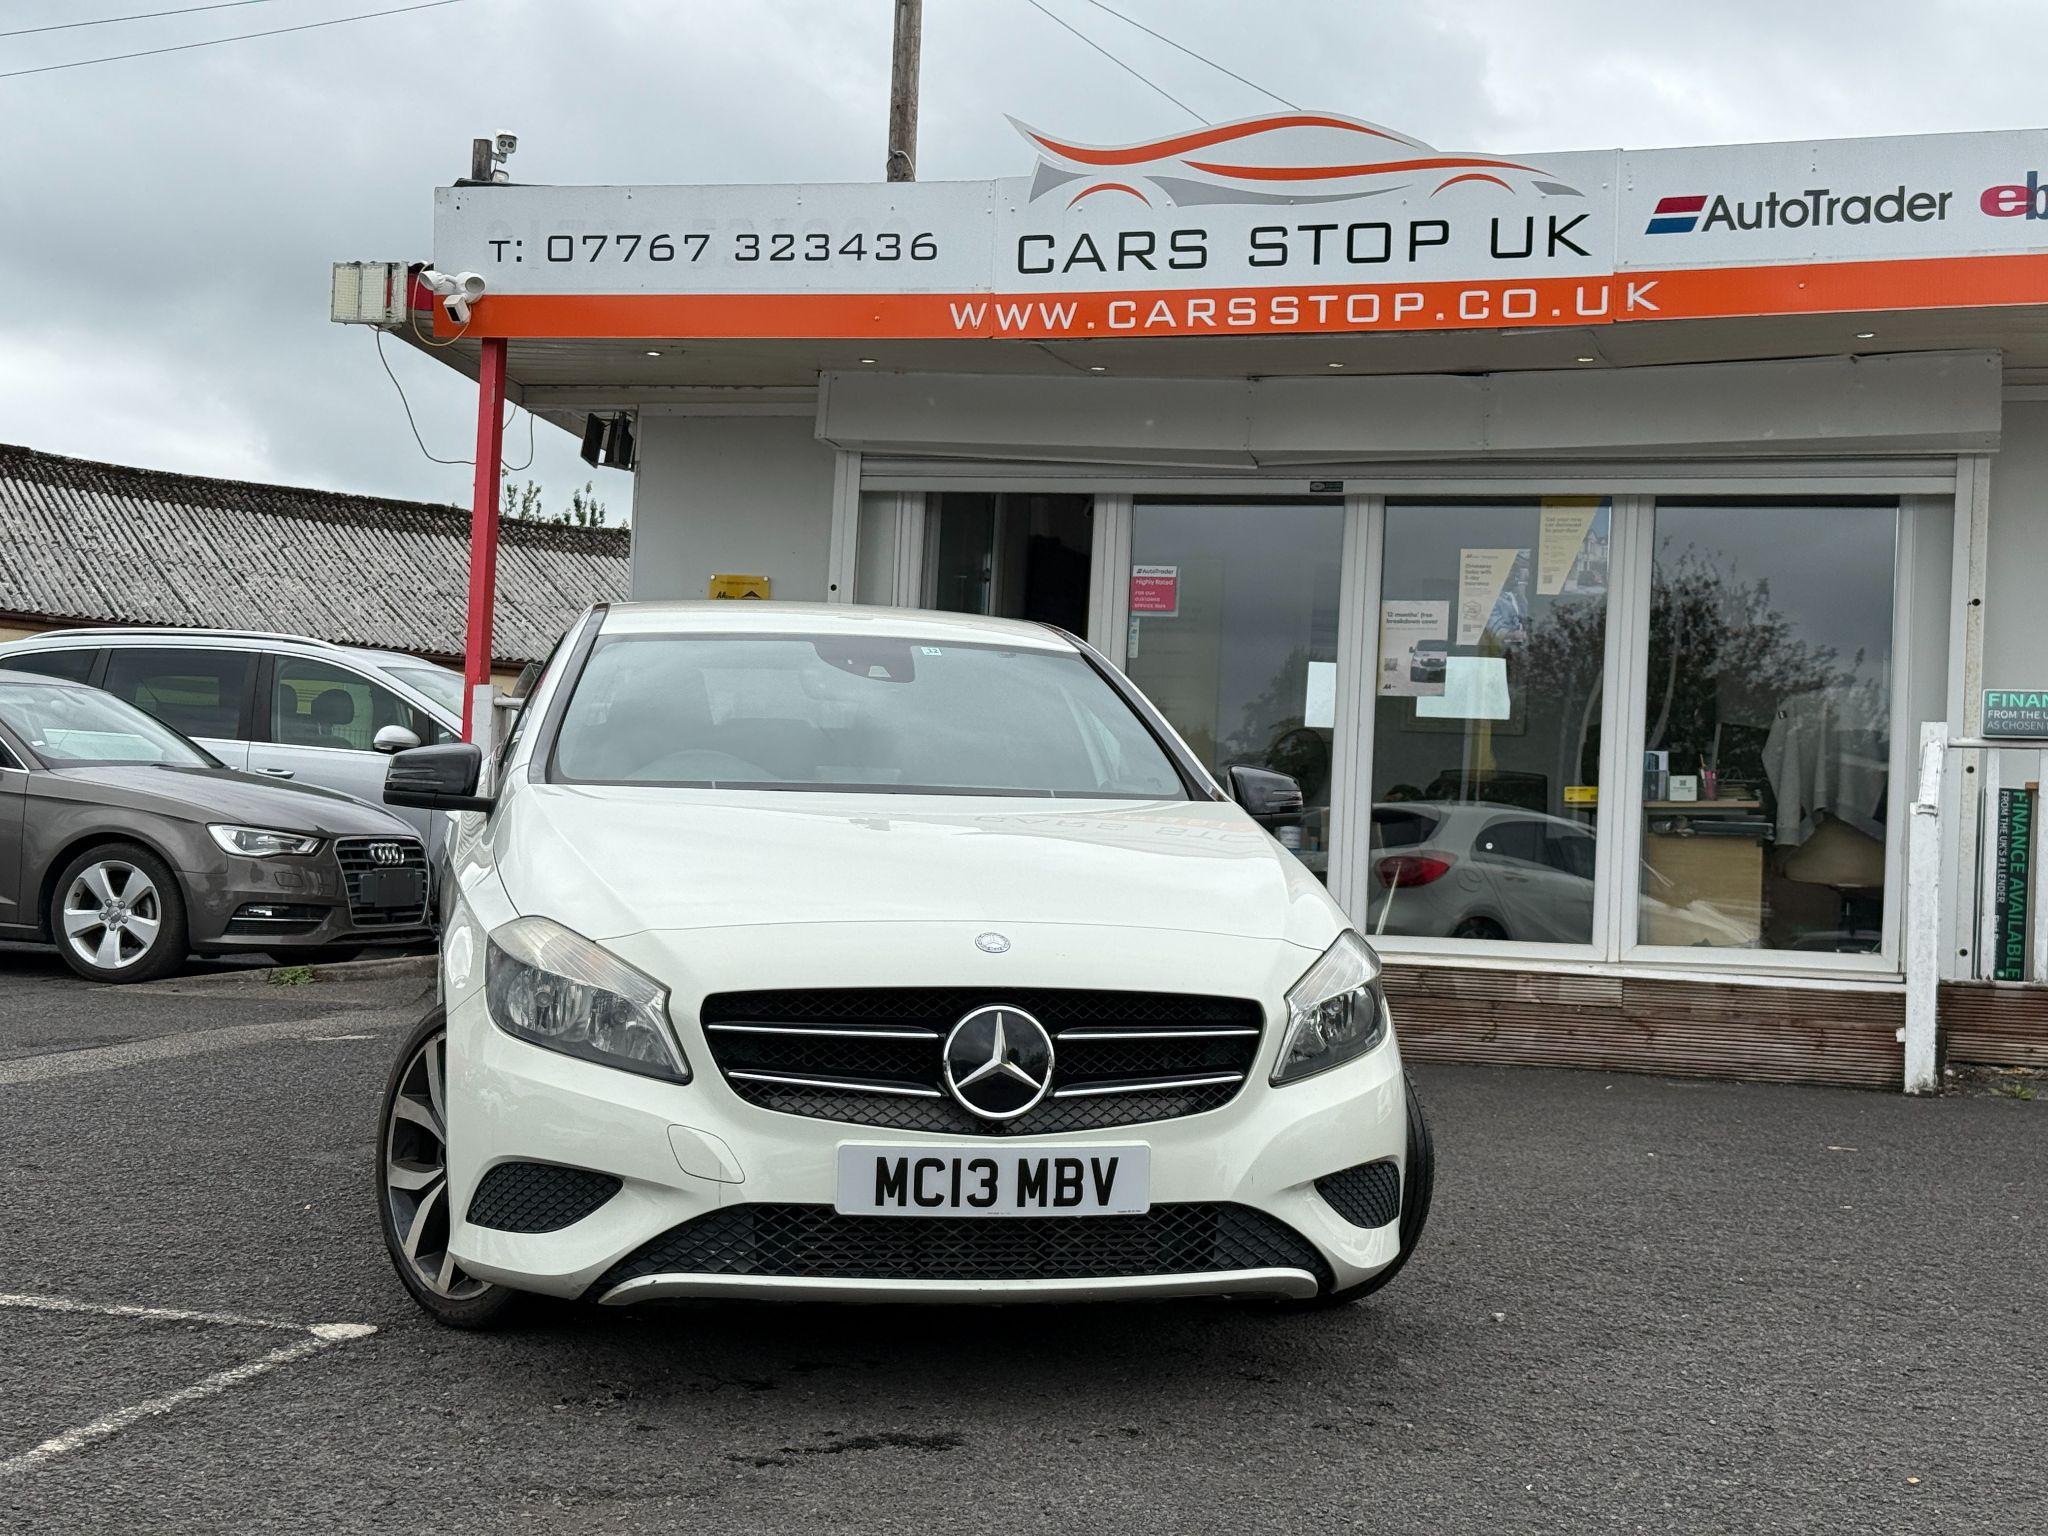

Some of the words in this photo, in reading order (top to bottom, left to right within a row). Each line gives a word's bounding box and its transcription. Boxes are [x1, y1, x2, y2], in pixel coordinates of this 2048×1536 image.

[1701, 185, 1952, 232] AutoTrader
[488, 240, 523, 263] T:
[547, 233, 710, 263] 07767
[735, 232, 938, 262] 323436
[1018, 228, 1208, 274] CARS
[1248, 219, 1450, 267] STOP
[1490, 213, 1592, 259] UK
[949, 281, 1660, 331] WWW.CARSSTOP.CO.UK
[1987, 720, 2000, 729] AS
[2002, 721, 2044, 731] CHOSEN
[1988, 710, 2017, 719] FROM
[2020, 710, 2040, 719] THE
[2000, 790, 2010, 816] FROM
[1999, 817, 2009, 834] THE
[2010, 791, 2028, 873] FINANCE
[1997, 868, 2006, 904] LENDER
[2005, 877, 2025, 978] AVAILABLE
[875, 1156, 999, 1208] MC13
[1017, 1156, 1119, 1208] MBV
